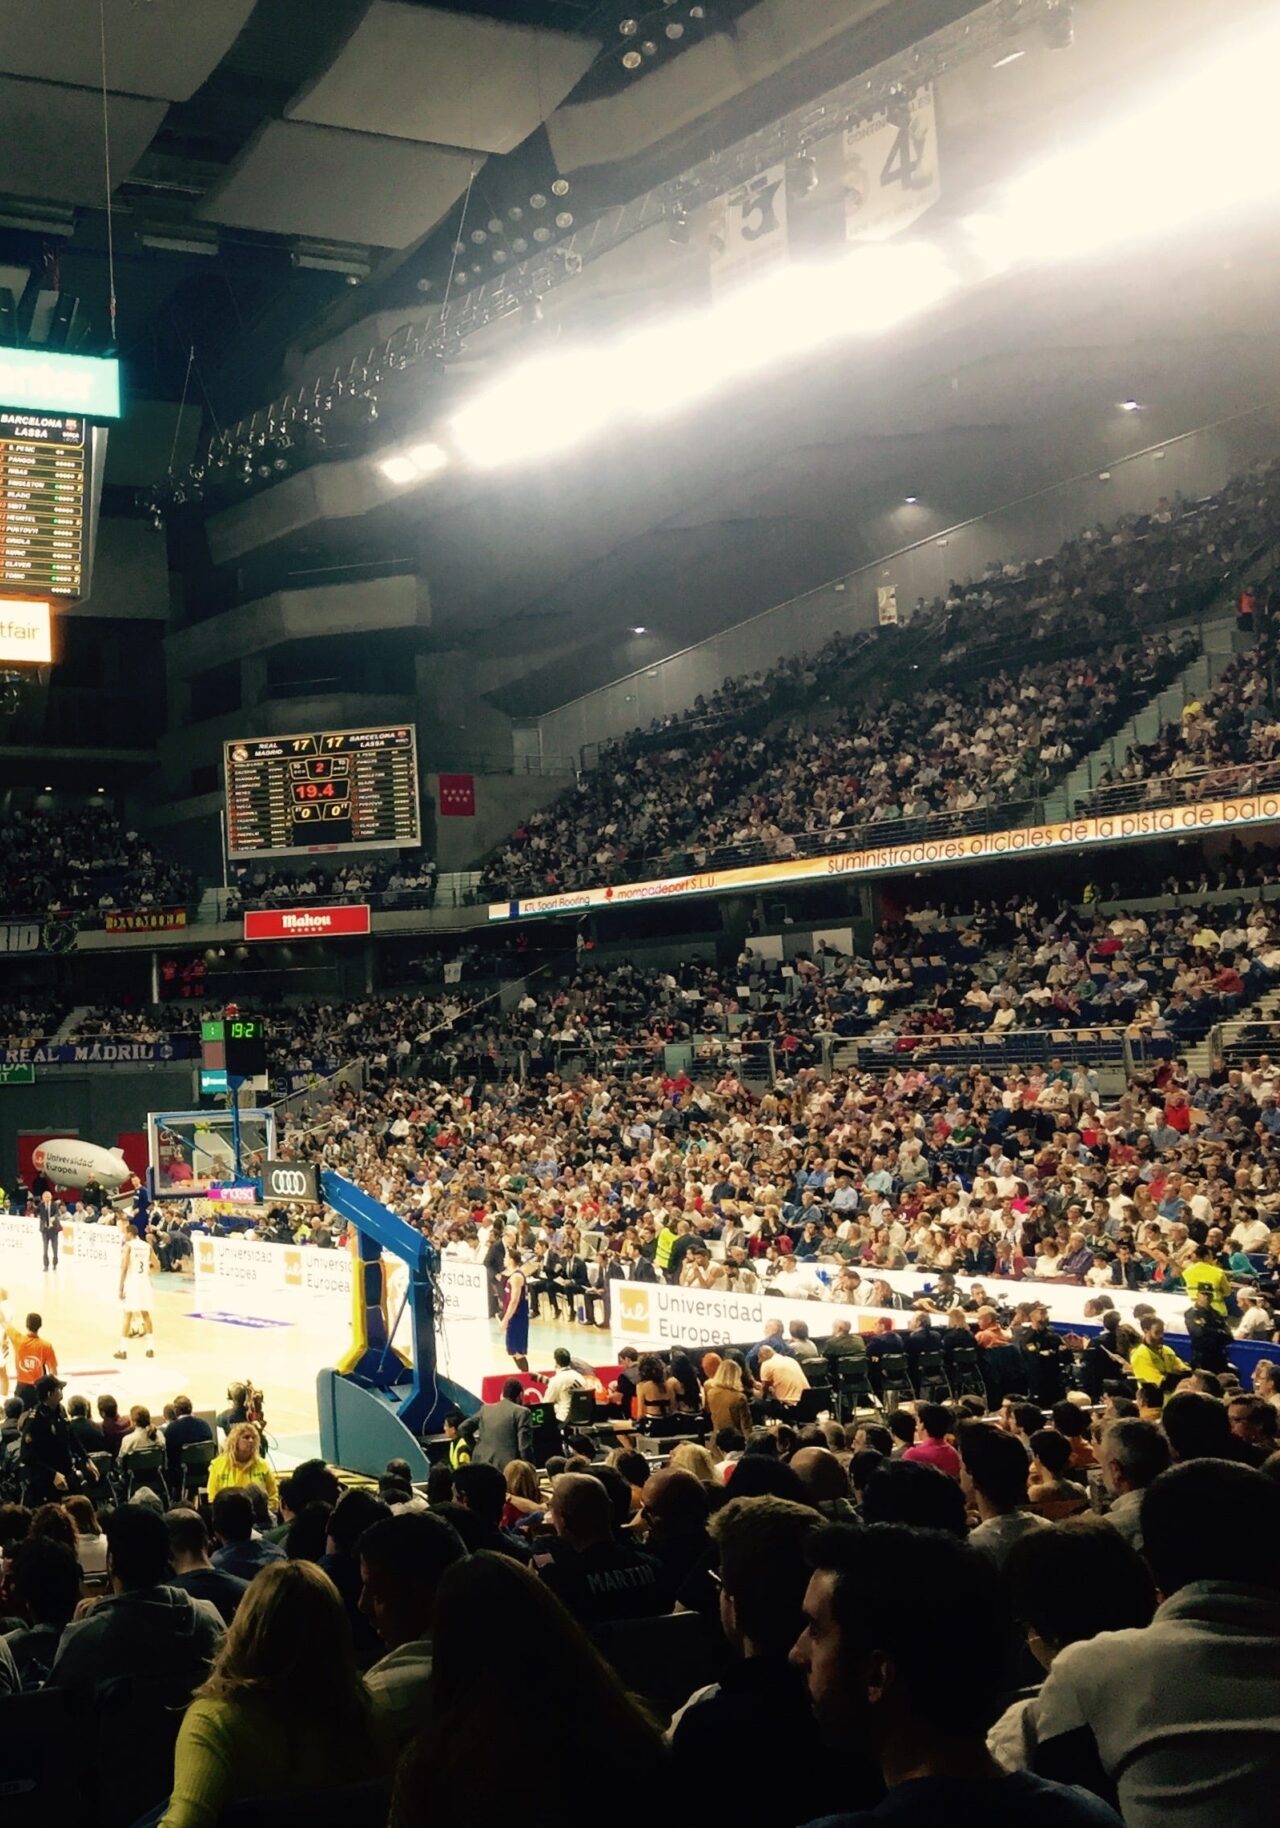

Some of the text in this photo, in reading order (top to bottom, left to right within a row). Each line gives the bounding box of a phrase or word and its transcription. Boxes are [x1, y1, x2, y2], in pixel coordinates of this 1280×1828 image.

[0, 414, 63, 428] BARCELONA
[14, 428, 48, 438] LASSA
[326, 736, 344, 749] 17
[349, 733, 395, 742] BARCELONA
[360, 740, 385, 748] LASSA
[292, 739, 310, 752] 17
[254, 749, 283, 757] MADRID
[315, 762, 325, 773] 2
[296, 783, 335, 799] 19.4
[301, 808, 311, 819] 0
[331, 805, 341, 816] 0
[828, 838, 964, 874] suministradores
[969, 827, 1053, 855] oficiales
[1059, 819, 1088, 844] de
[1093, 814, 1114, 838] la
[1120, 808, 1175, 838] pista
[1182, 804, 1215, 828] de
[282, 913, 332, 929] Mahou
[5, 1046, 61, 1064] REAL
[658, 1292, 764, 1324] Universidad
[658, 1319, 732, 1347] Europea
